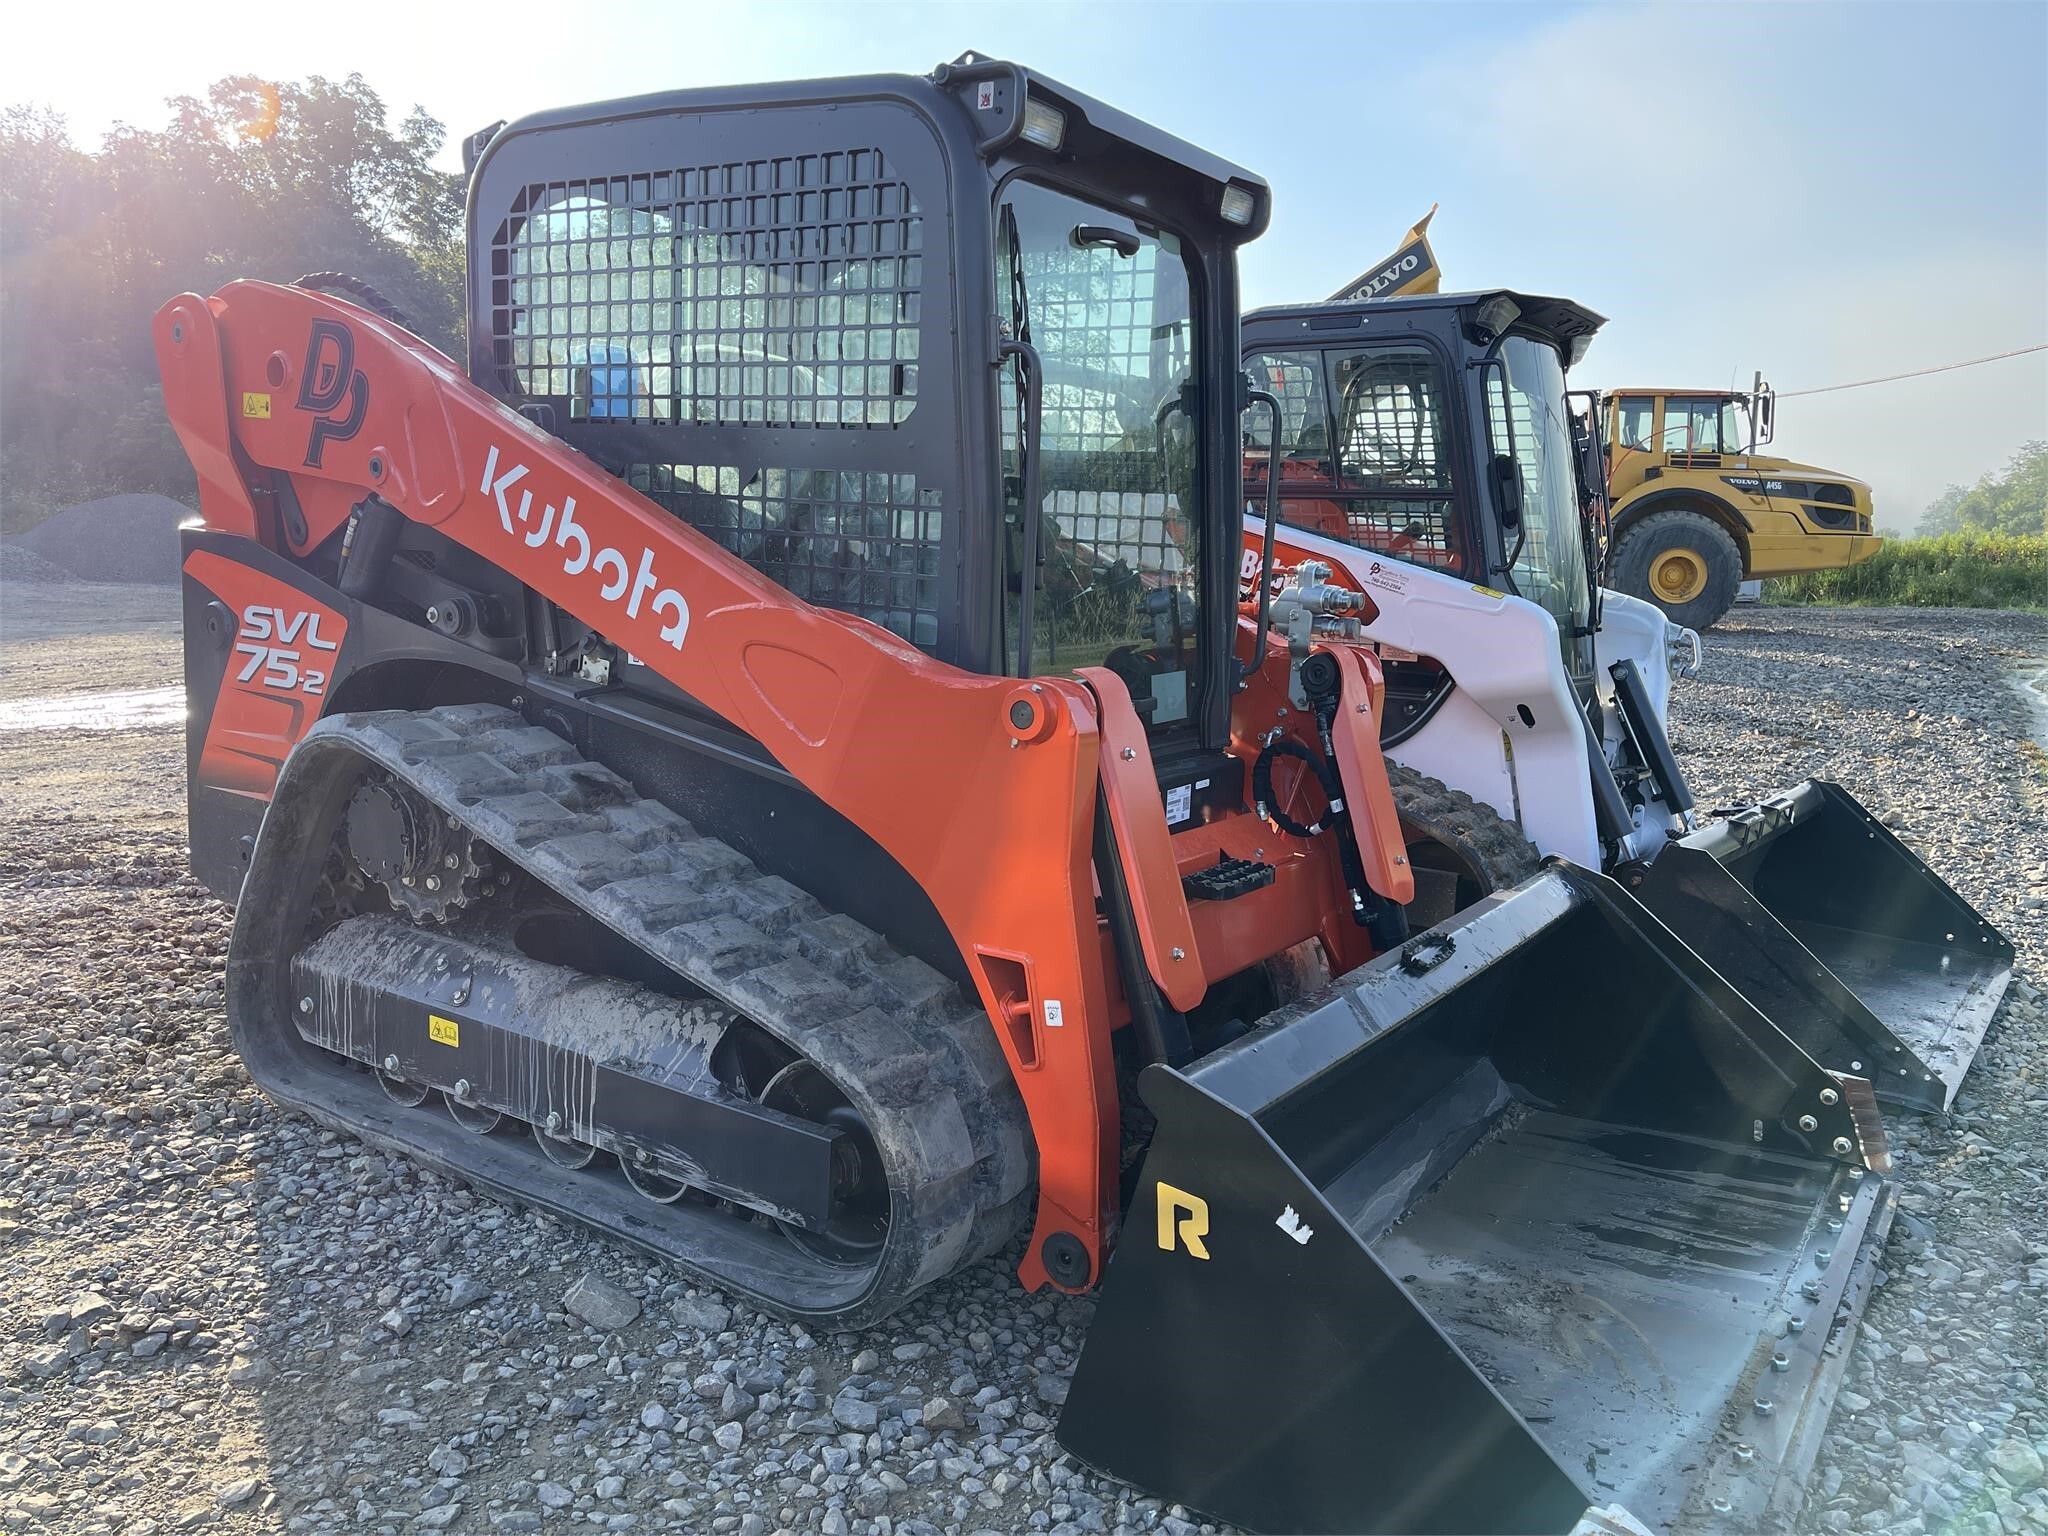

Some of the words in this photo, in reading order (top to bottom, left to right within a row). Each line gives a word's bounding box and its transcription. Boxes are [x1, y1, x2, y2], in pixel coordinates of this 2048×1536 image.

[1730, 478, 1759, 486] VOLVO
[1766, 481, 1782, 490] A45G
[480, 444, 690, 652] Kubota
[240, 605, 337, 651] SVL
[236, 642, 325, 695] 75-2
[1157, 1181, 1210, 1260] R
